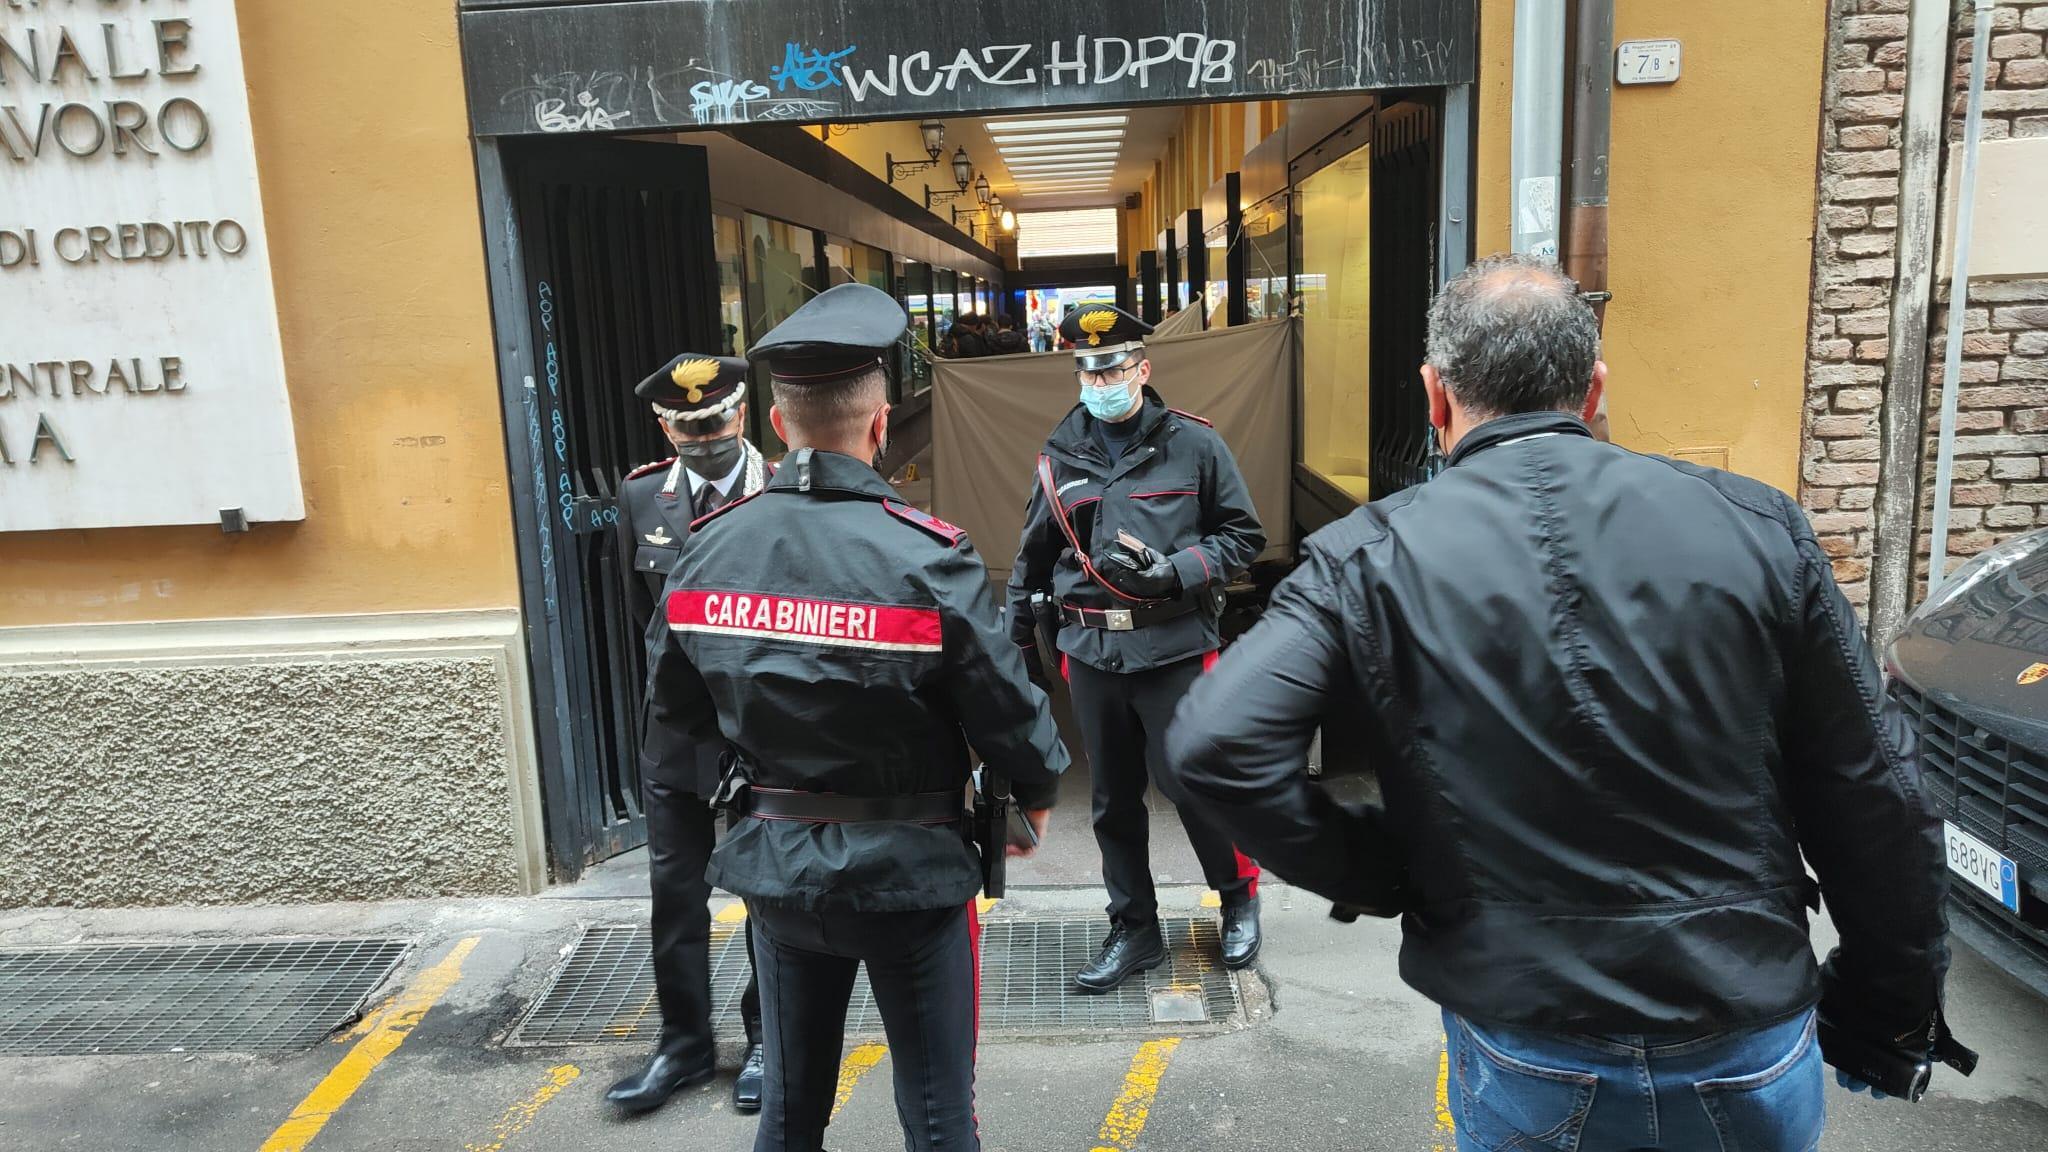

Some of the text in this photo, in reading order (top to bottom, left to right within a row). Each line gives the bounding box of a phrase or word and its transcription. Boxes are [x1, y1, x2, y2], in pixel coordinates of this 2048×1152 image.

[0, 17, 201, 86] NALE
[0, 218, 247, 266] DI CREDITO
[704, 594, 877, 640] CARABINIERI
[1950, 837, 1999, 890] 688VG
